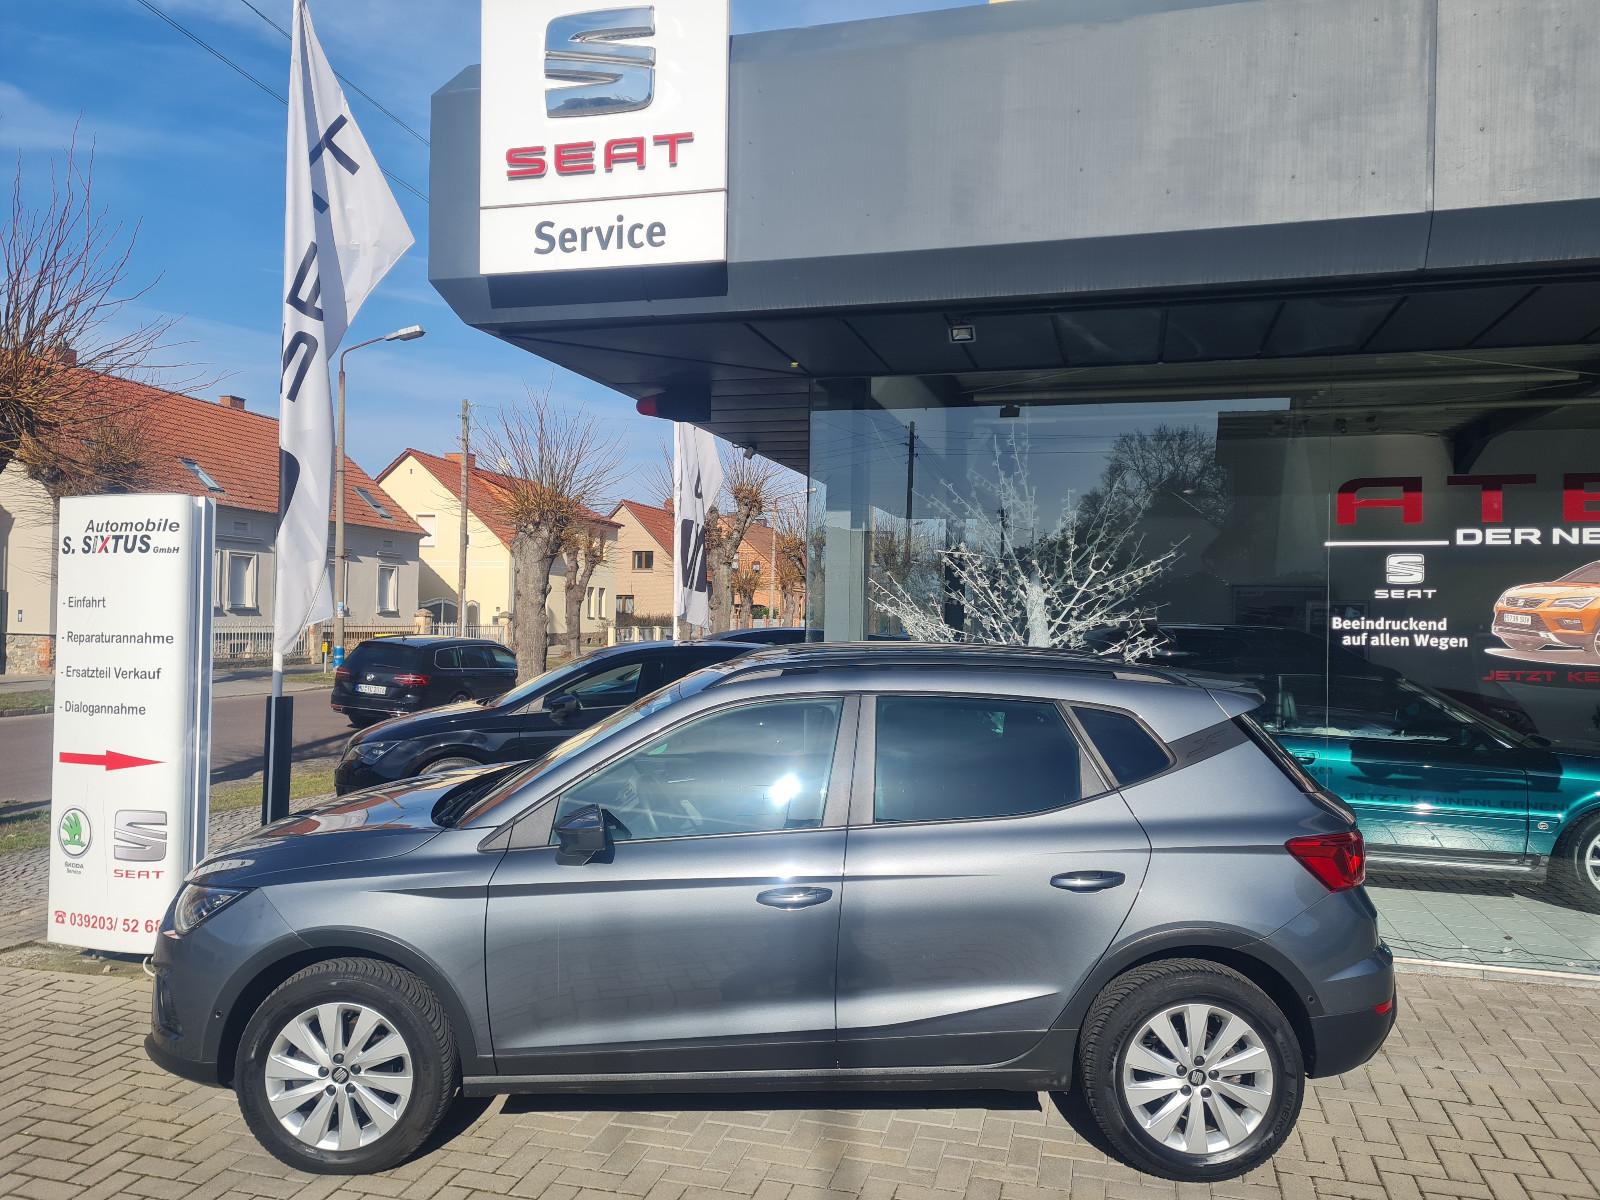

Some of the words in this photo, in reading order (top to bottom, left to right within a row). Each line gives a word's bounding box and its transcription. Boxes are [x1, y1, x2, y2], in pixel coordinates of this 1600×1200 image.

[506, 132, 694, 181] SEAT
[534, 214, 666, 255] Service
[85, 518, 180, 532] Automobile
[81, 534, 152, 554] SIXTUS
[153, 546, 180, 554] GmbH
[1456, 528, 1542, 545] DER
[1552, 528, 1600, 545] NE
[1374, 589, 1437, 599] SEAT
[68, 596, 106, 608] Einfahrt
[1332, 617, 1448, 632] Beeindruckend
[67, 631, 174, 645] Reparaturannahme
[1342, 633, 1368, 646] auf
[1370, 633, 1410, 647] allen
[1414, 635, 1469, 650] Wegen
[66, 665, 111, 679] Ersatzteil
[113, 667, 162, 680] Verkauf
[1483, 670, 1556, 683] JETZT
[1567, 671, 1600, 683] KE
[65, 700, 146, 717] Dialogannahme
[113, 869, 165, 880] SEAT
[122, 918, 139, 933] 52
